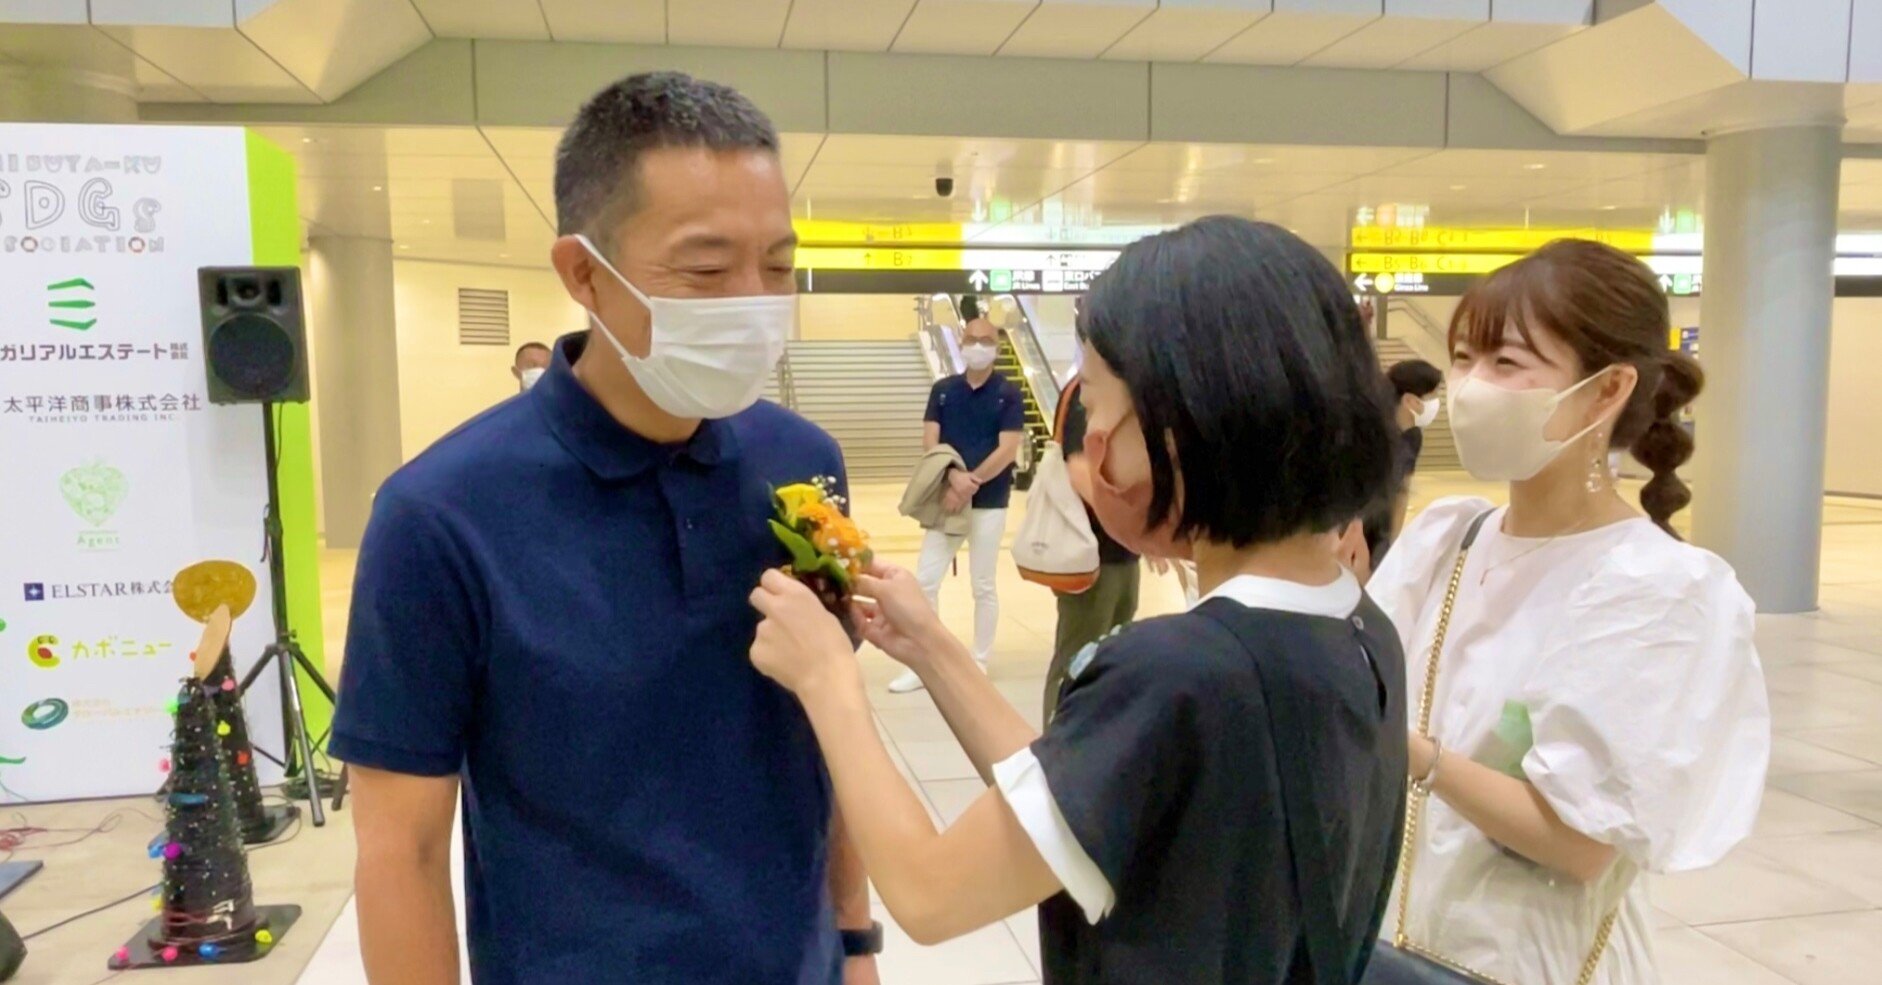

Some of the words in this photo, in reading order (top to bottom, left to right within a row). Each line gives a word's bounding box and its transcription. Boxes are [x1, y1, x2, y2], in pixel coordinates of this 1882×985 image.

[0, 343, 167, 361] ガリアルエステート
[4, 393, 201, 414] 太平洋商事株式会社
[95, 414, 148, 422] TRADING
[72, 635, 172, 660] カボニュー
